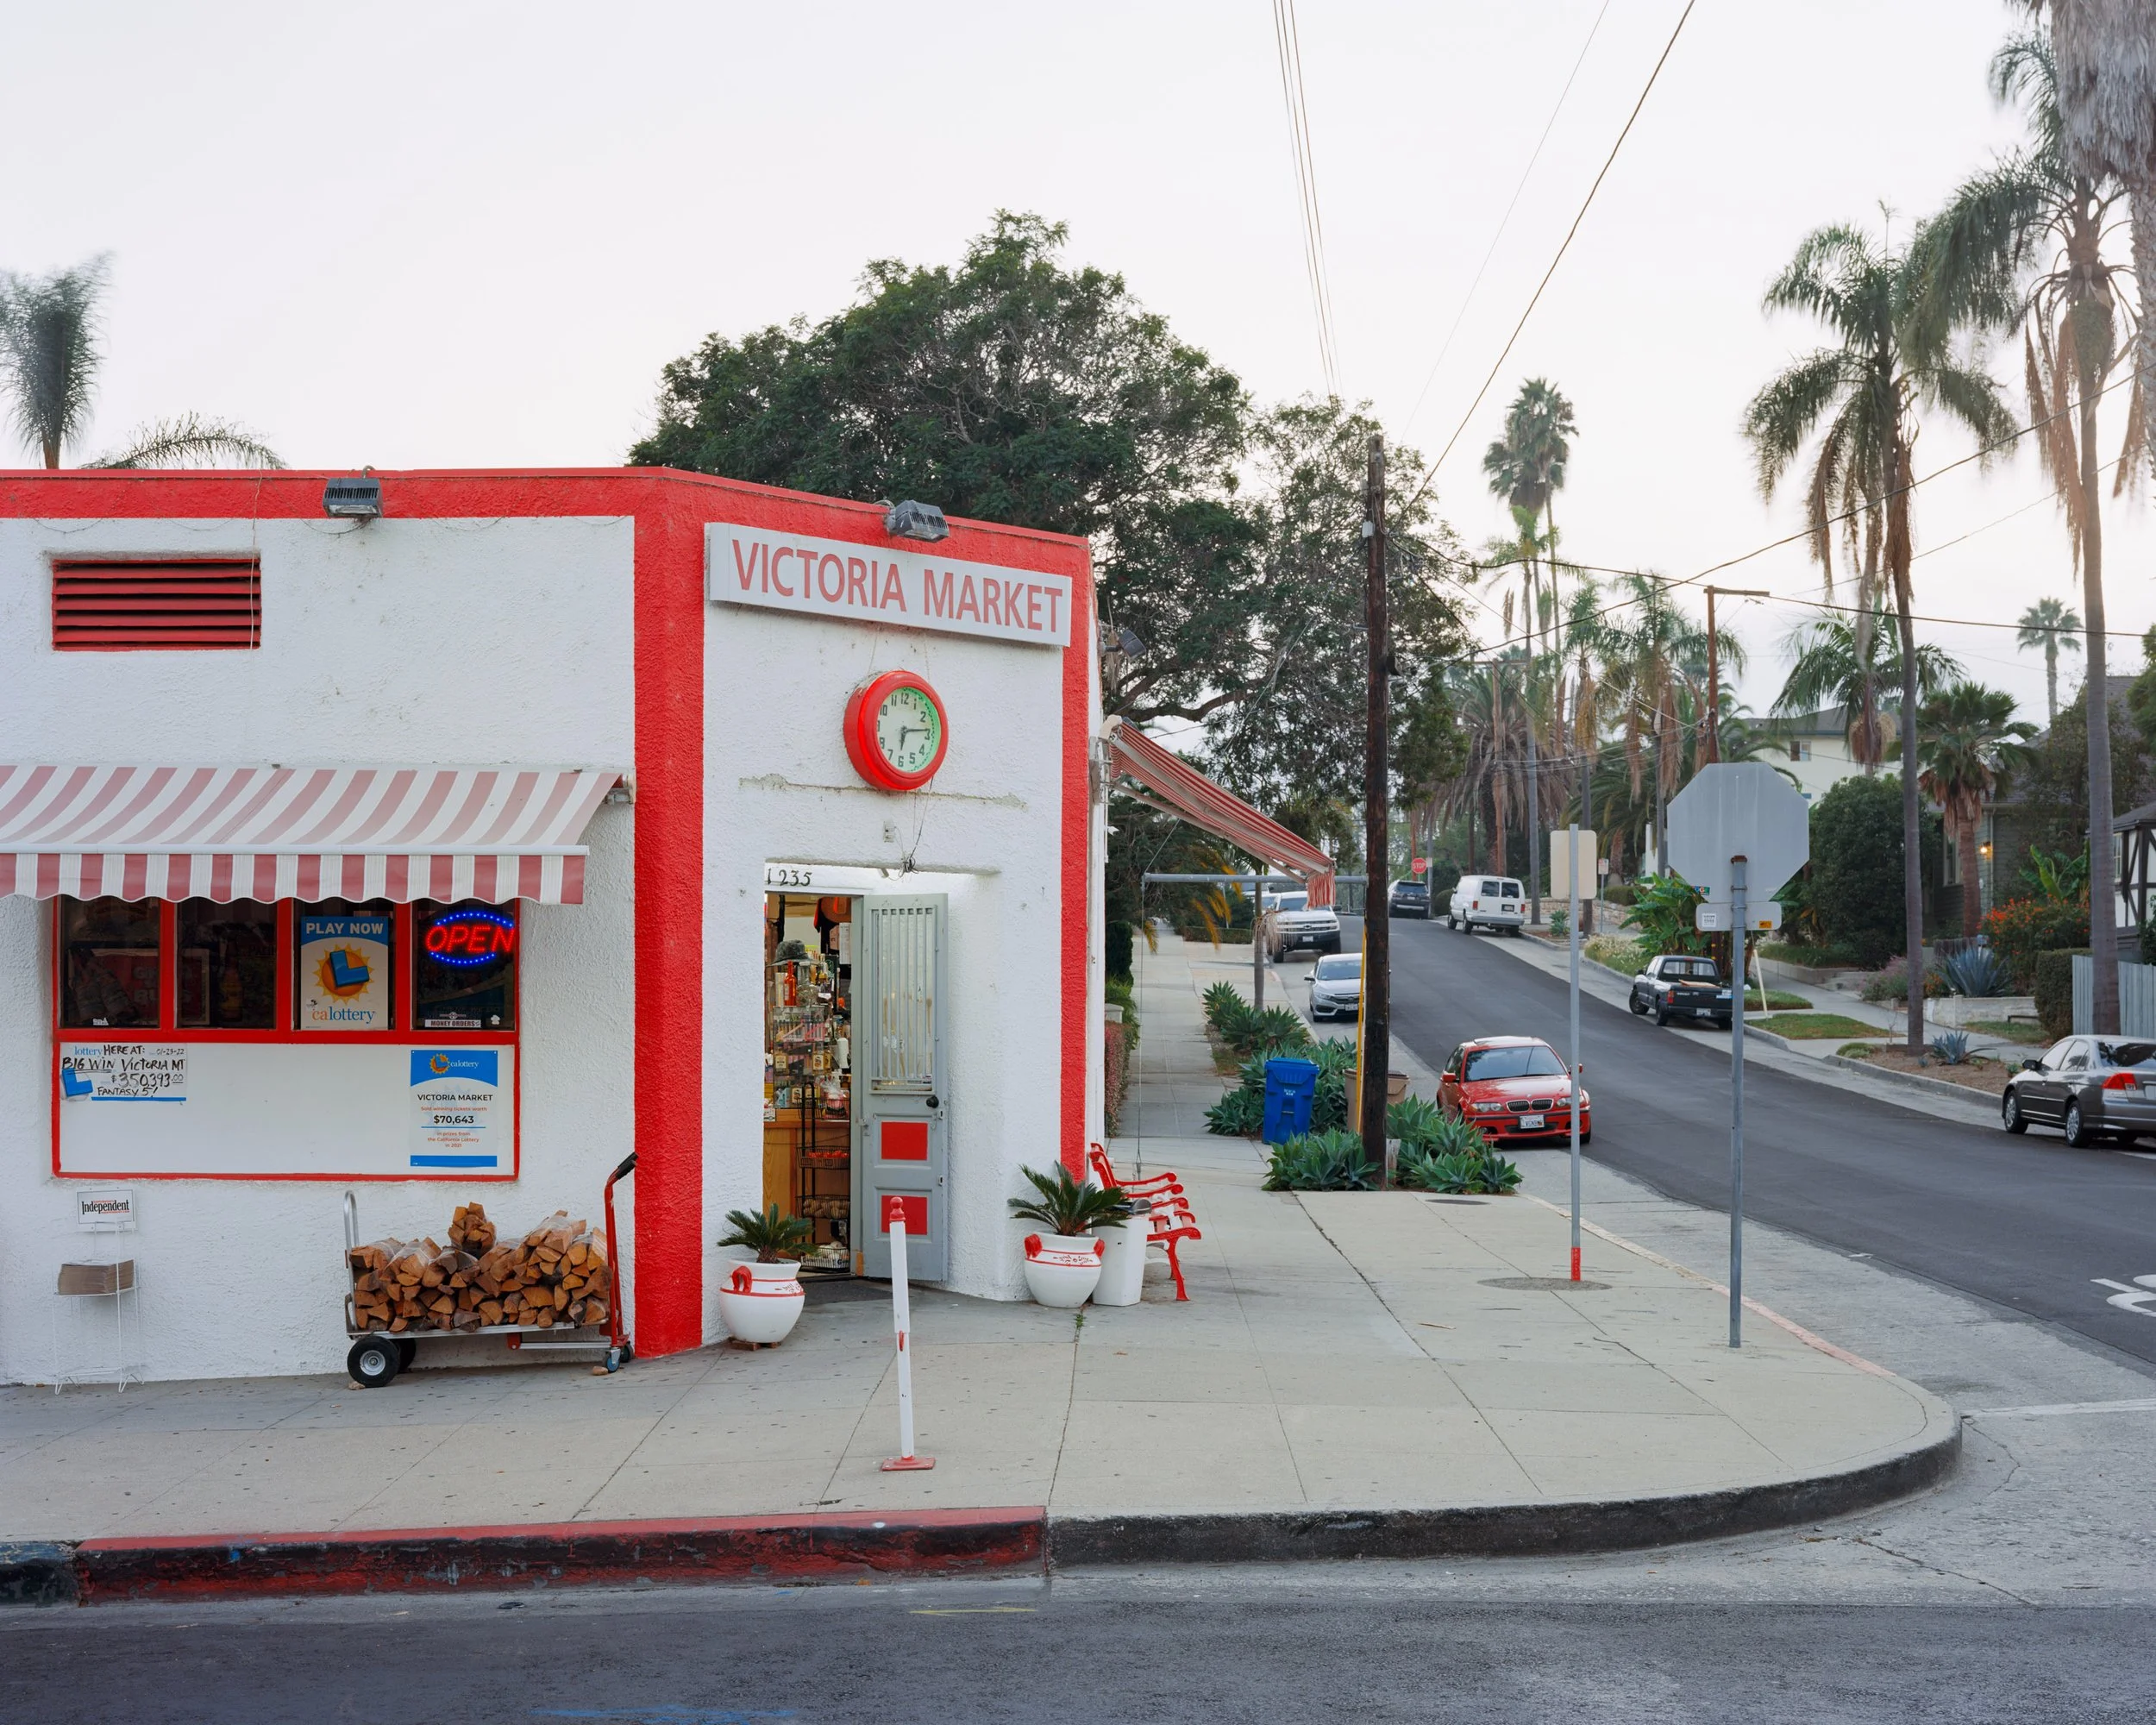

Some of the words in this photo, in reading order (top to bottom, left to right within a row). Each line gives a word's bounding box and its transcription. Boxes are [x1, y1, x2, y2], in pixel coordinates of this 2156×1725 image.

[732, 539, 906, 612] VICTORIA
[924, 569, 1062, 632] MARKET
[891, 694, 897, 706] 11
[900, 693, 909, 705] 12
[920, 711, 926, 723] 2
[887, 749, 893, 760] 7
[918, 744, 925, 756] 4
[898, 756, 904, 767] 6
[909, 752, 916, 764] 5
[768, 868, 812, 886] 1235
[306, 923, 344, 934] PLAY
[349, 923, 384, 934] NOW
[425, 925, 515, 952] OPEN
[311, 1006, 375, 1024] calottery
[74, 1045, 103, 1057] lottery
[103, 1044, 128, 1056] HERE
[62, 1057, 85, 1070] BIG
[122, 1057, 167, 1071] VICTORIA
[450, 1060, 479, 1069] calottery
[97, 1087, 139, 1097] FANTASY
[434, 1114, 474, 1125] $70,643
[81, 1199, 129, 1214] Independent
